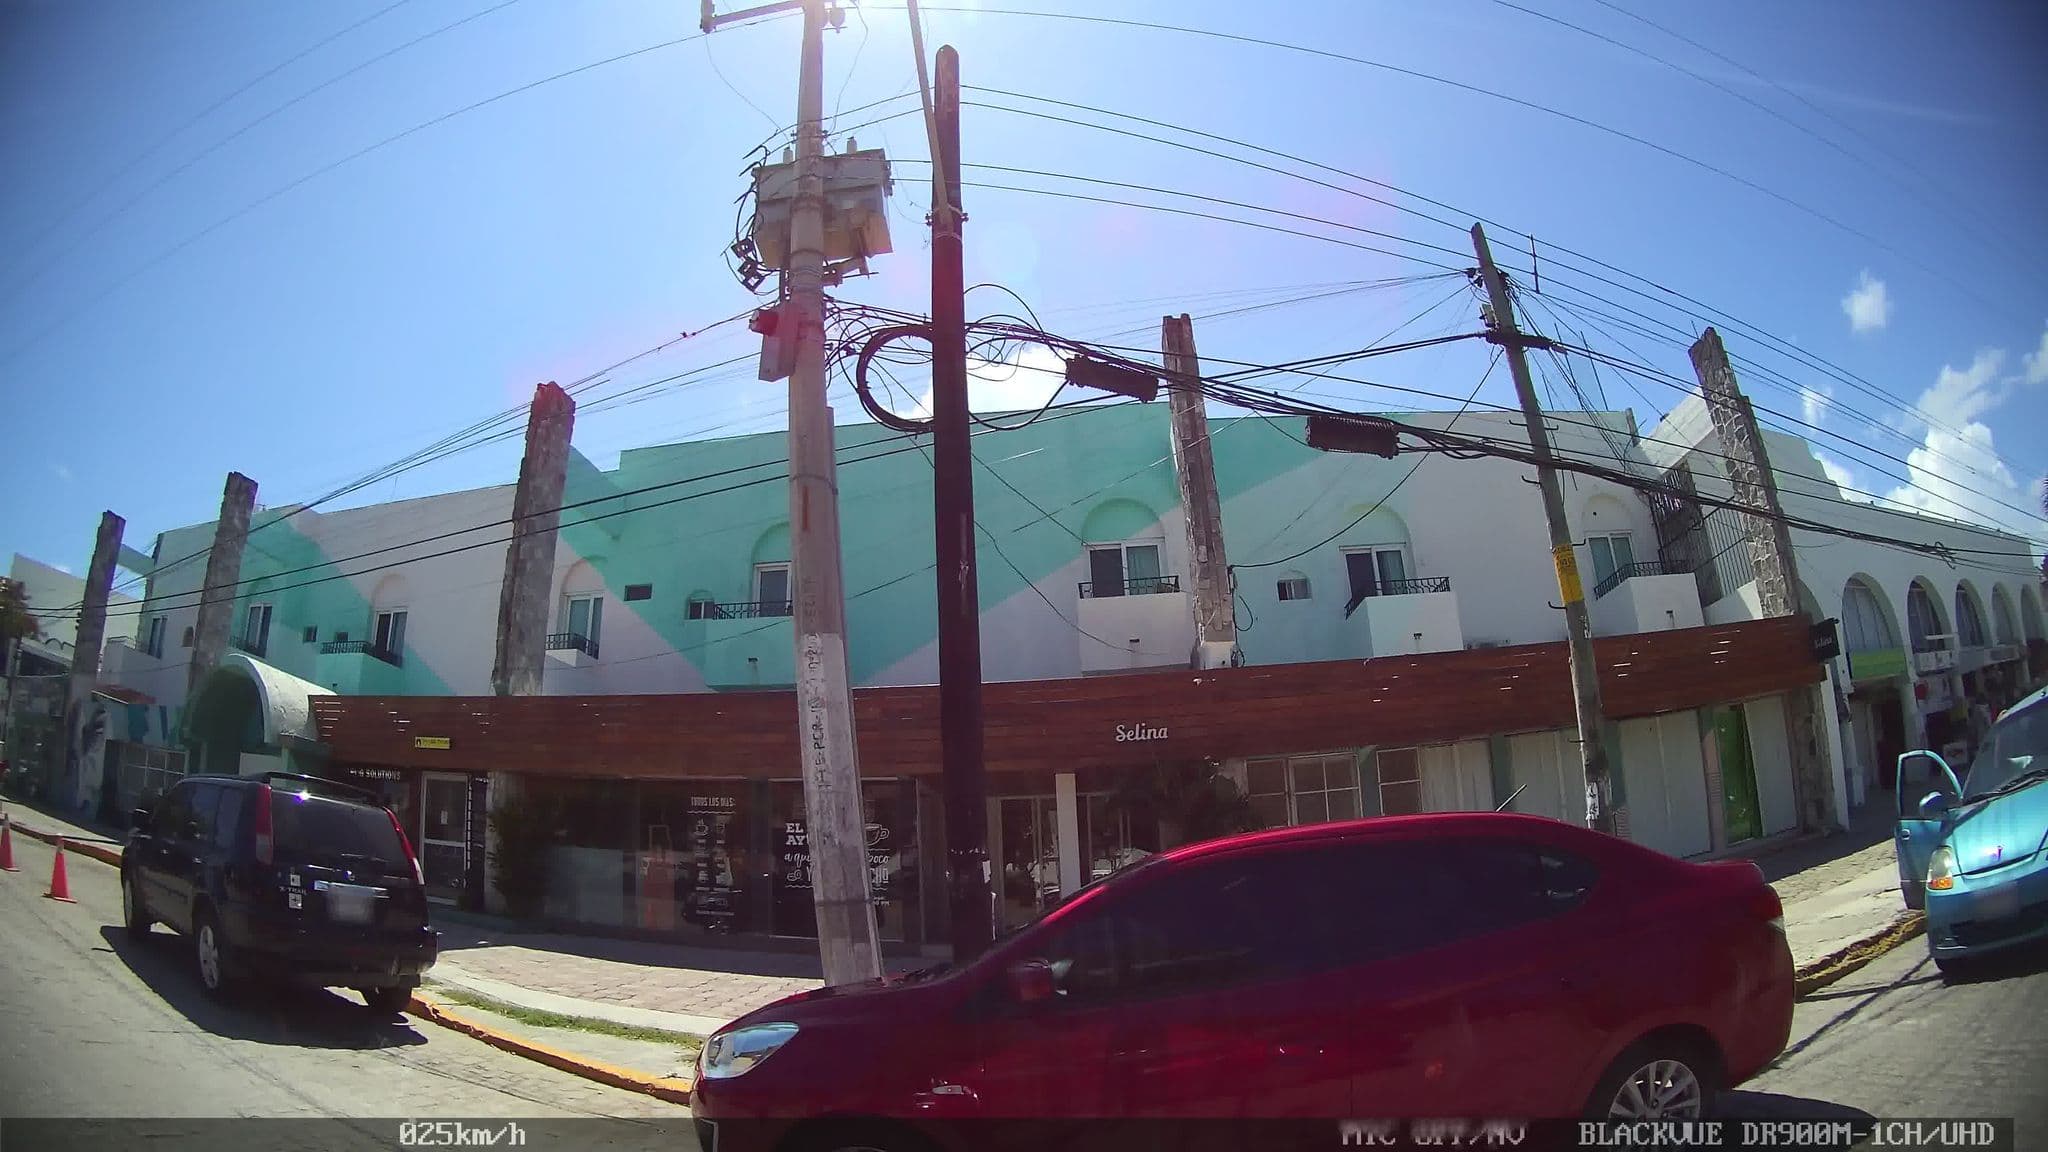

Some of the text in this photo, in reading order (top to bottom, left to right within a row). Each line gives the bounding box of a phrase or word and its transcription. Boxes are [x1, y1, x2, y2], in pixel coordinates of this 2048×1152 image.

[1115, 722, 1168, 742] Selina
[365, 768, 401, 781] SOLUTIONS
[785, 822, 804, 833] EL
